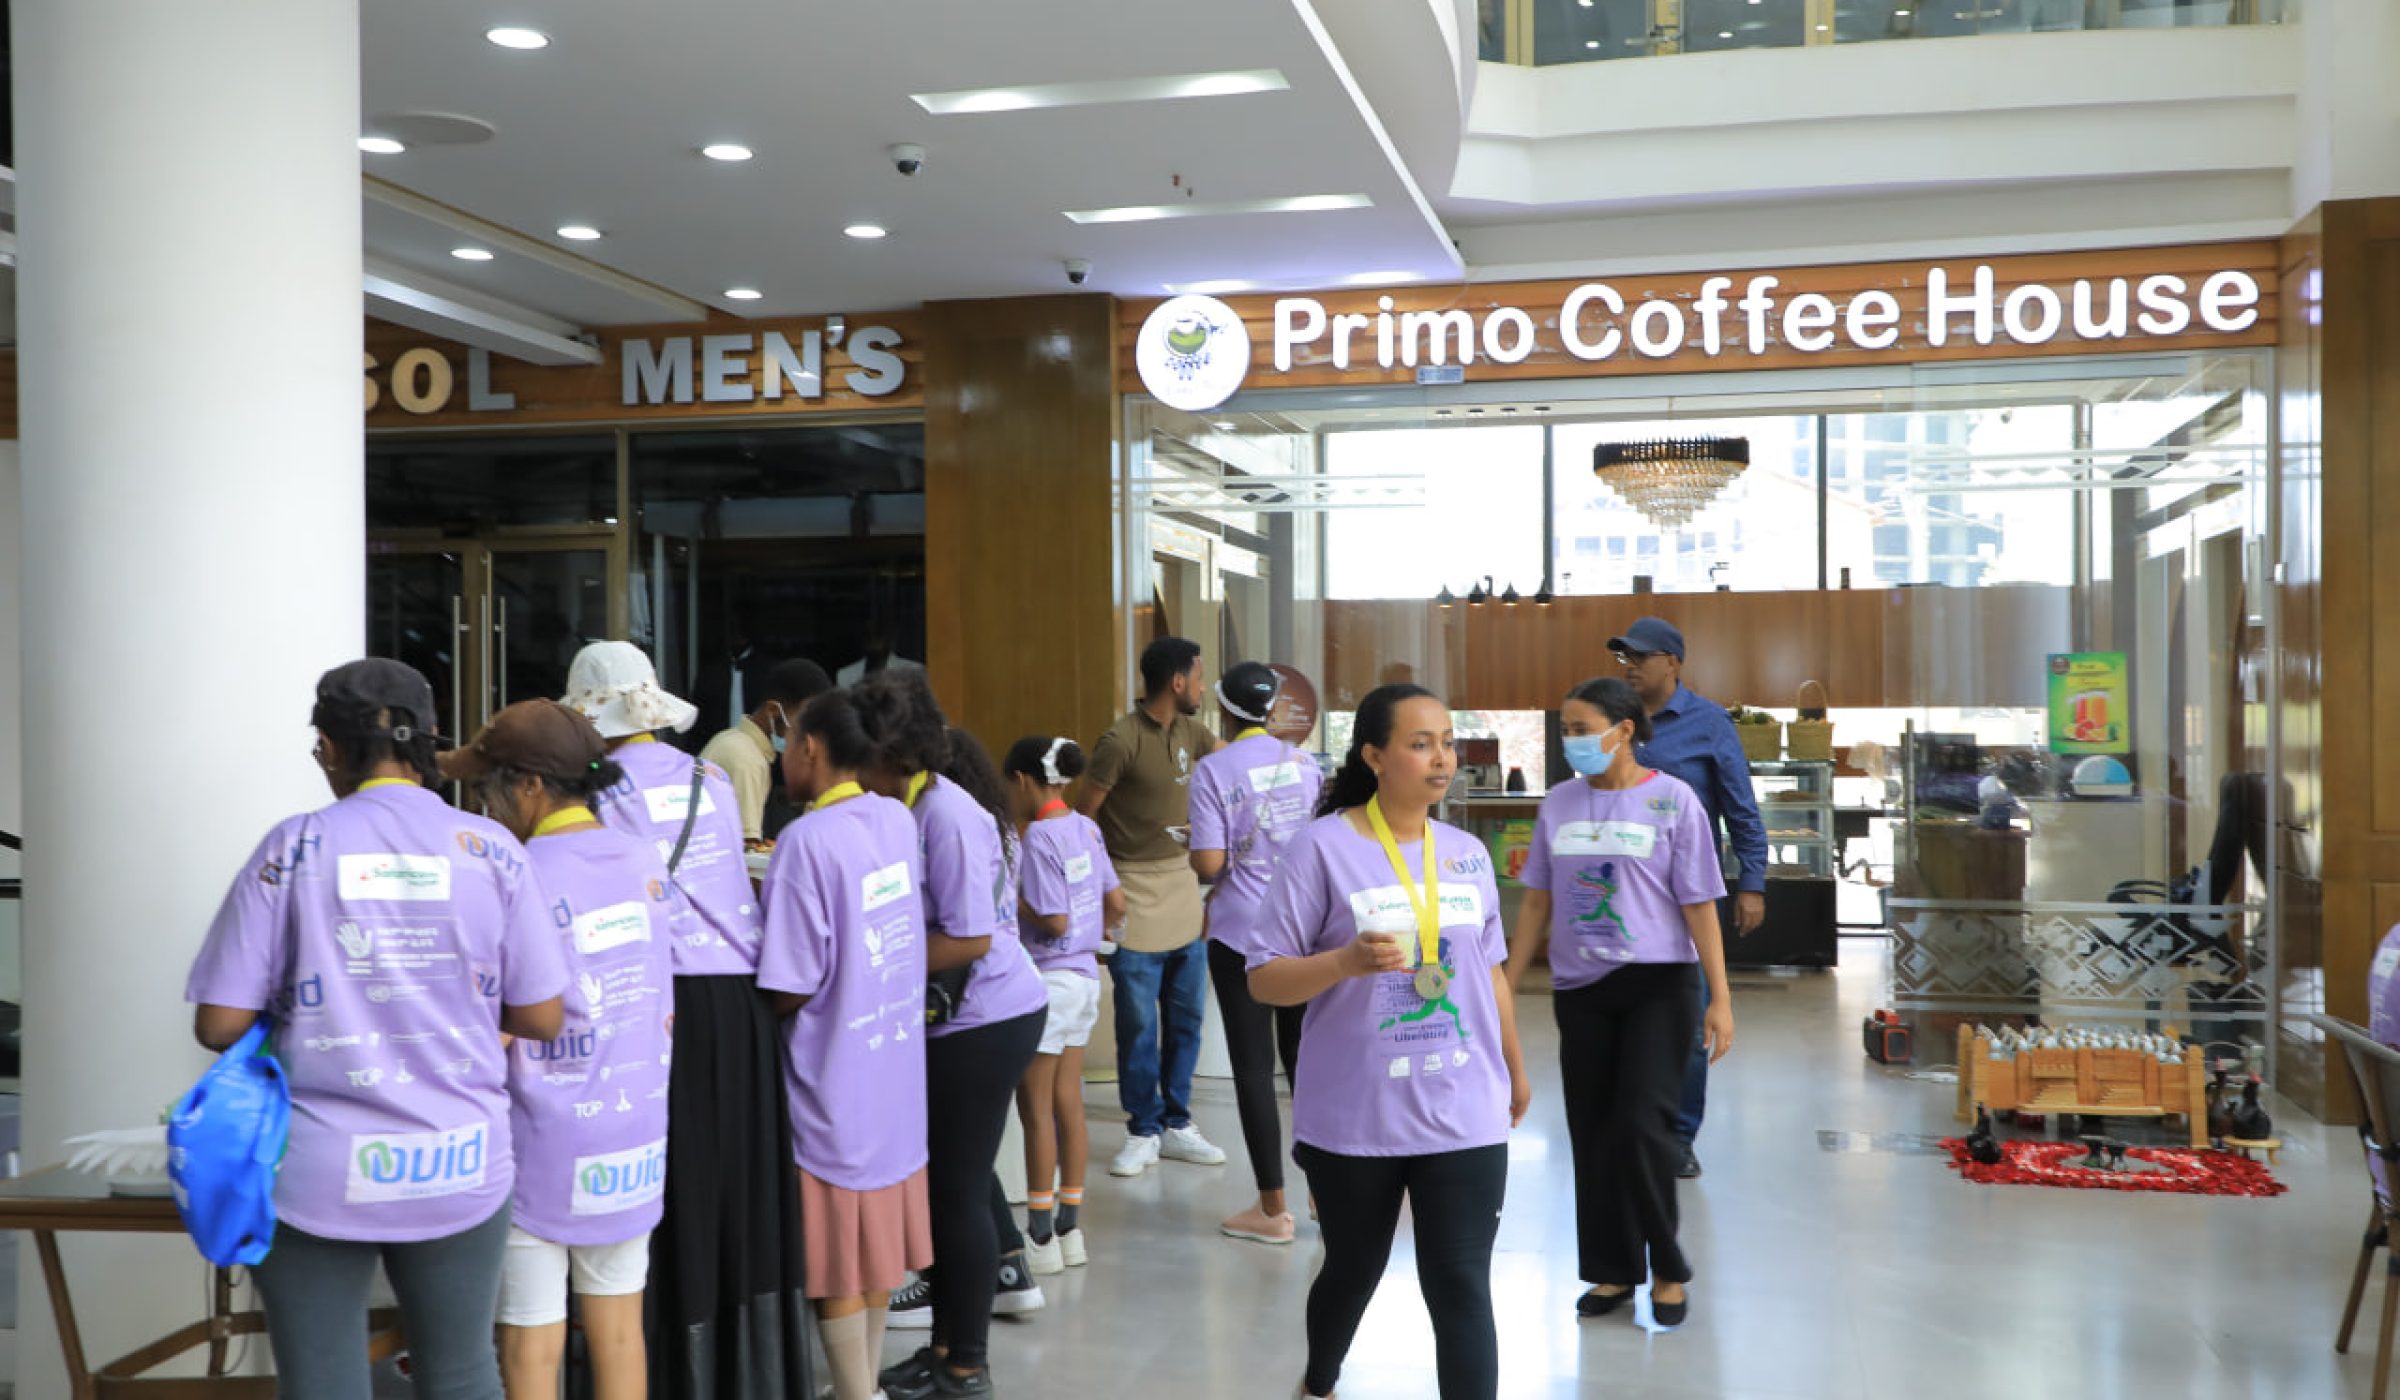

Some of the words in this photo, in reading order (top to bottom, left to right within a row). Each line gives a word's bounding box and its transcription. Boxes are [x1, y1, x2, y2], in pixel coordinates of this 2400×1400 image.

[366, 346, 516, 413] OL
[621, 317, 905, 406] MEN'S
[1274, 295, 1535, 372] Primo
[1559, 276, 1900, 359] Coffee
[1927, 264, 2259, 346] House
